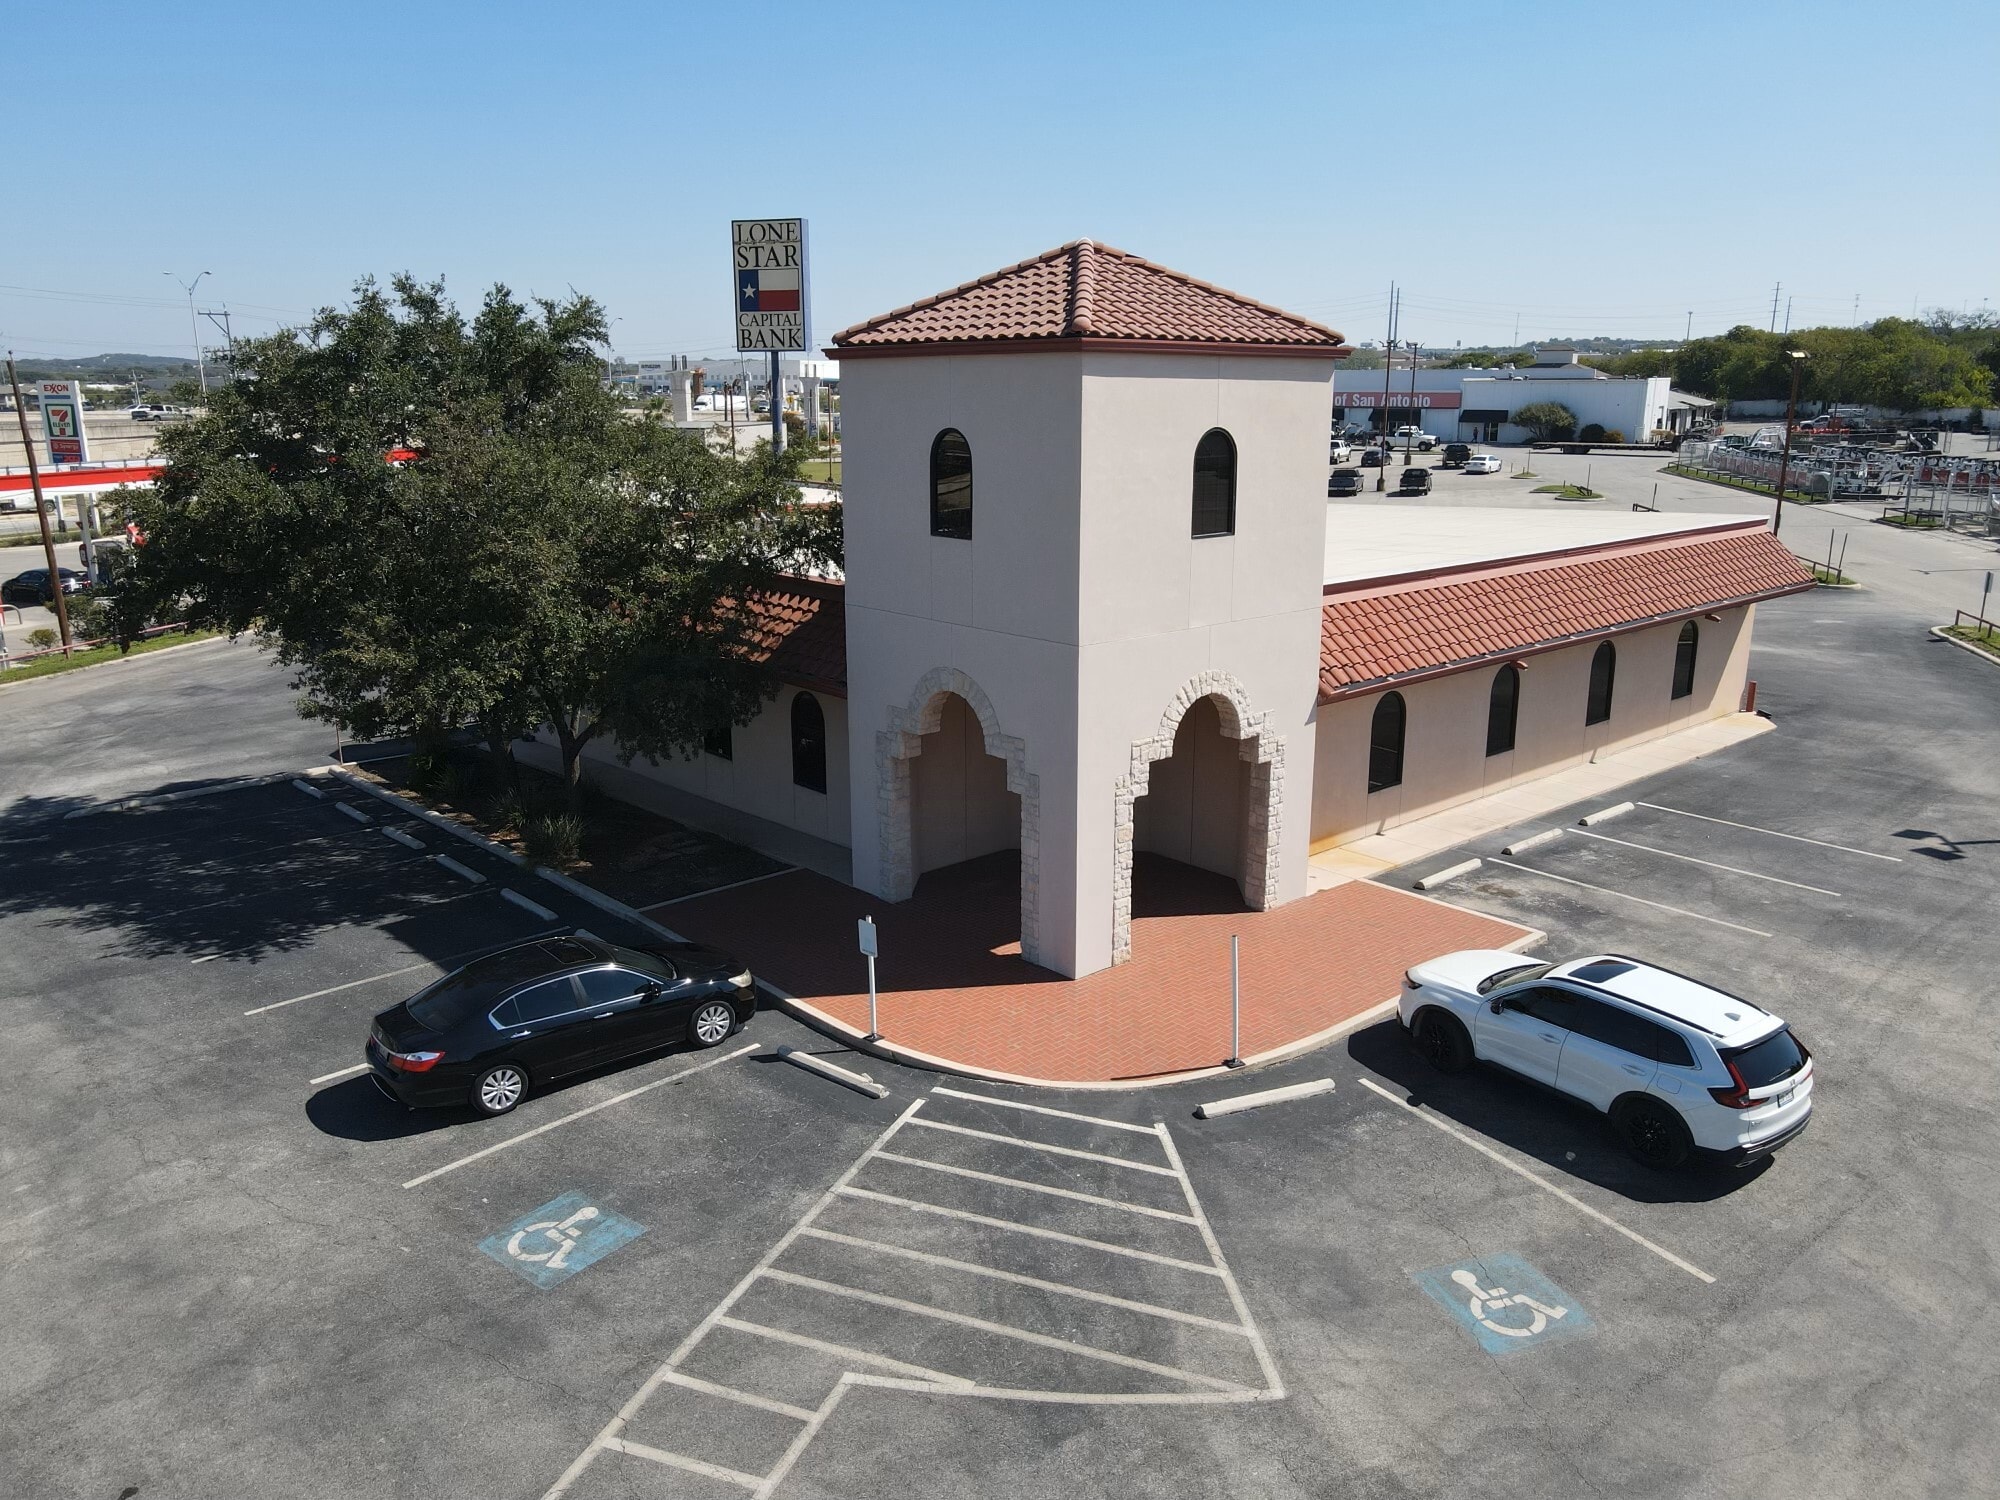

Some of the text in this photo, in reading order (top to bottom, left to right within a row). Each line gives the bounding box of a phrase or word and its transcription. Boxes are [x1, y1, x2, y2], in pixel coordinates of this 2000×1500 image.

[736, 222, 798, 244] LONE
[737, 245, 799, 268] STAR
[739, 313, 802, 326] CAPITAL
[740, 329, 802, 348] BANK
[44, 384, 69, 394] EXXON
[1334, 394, 1431, 408] of San Antonio
